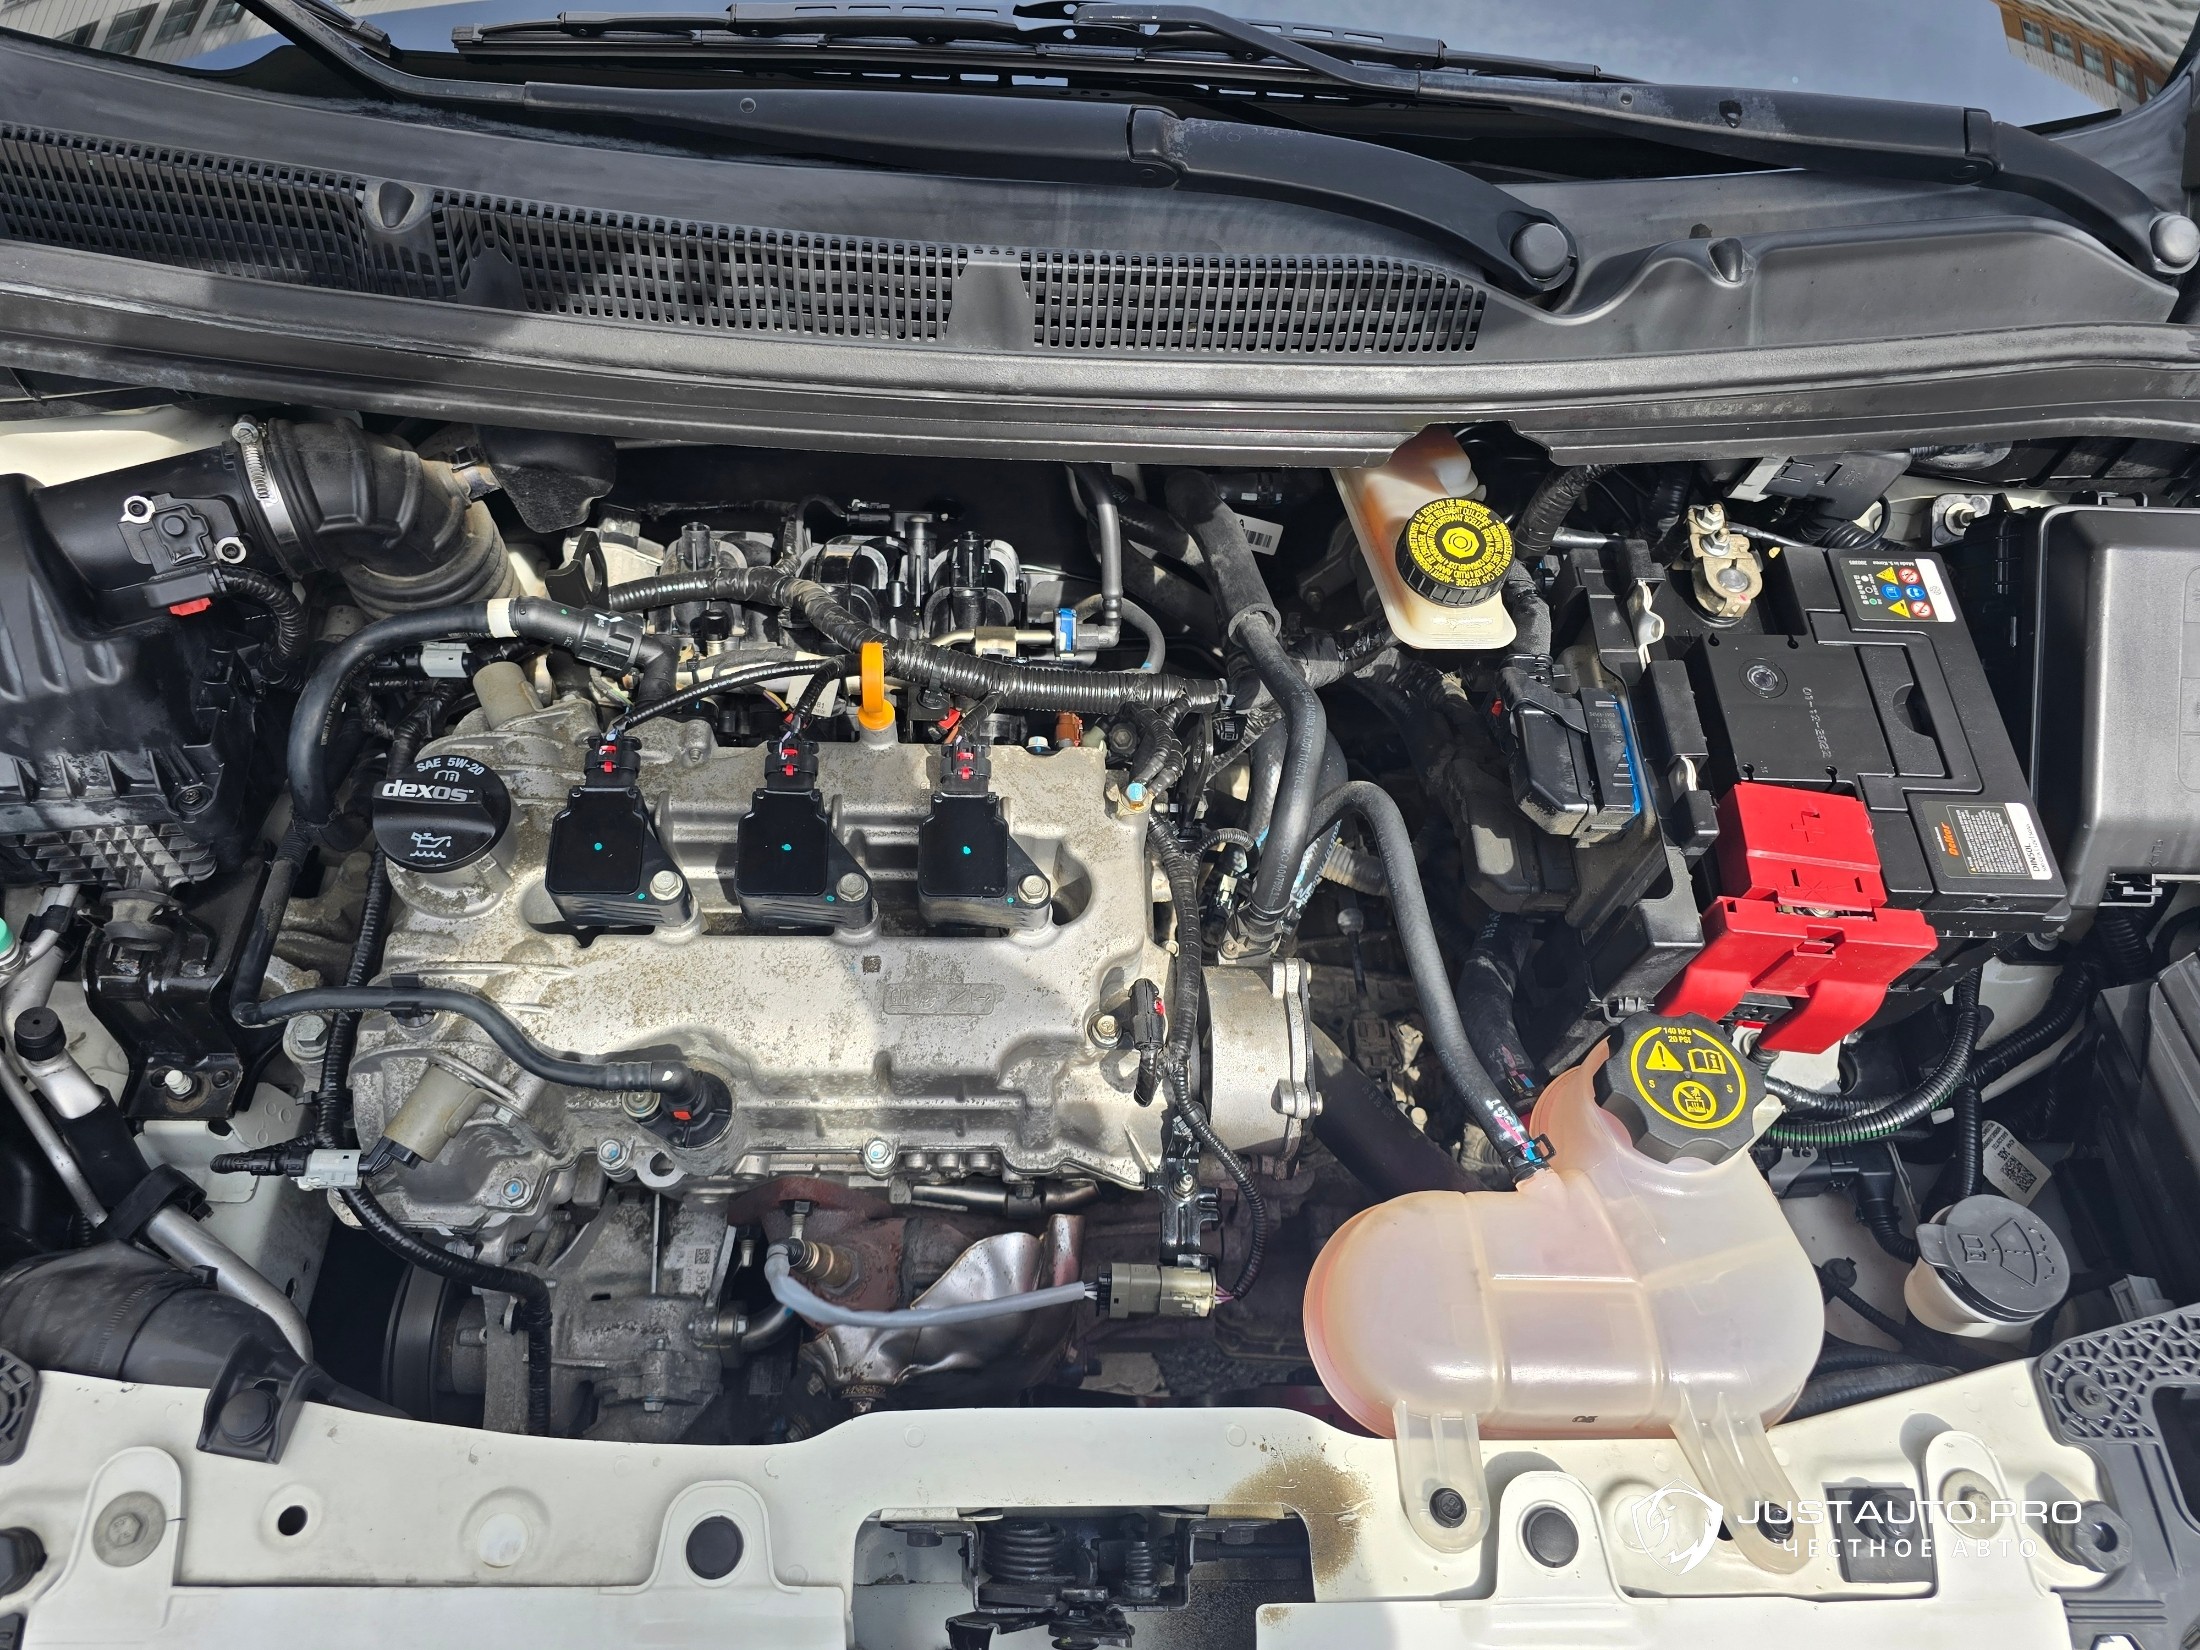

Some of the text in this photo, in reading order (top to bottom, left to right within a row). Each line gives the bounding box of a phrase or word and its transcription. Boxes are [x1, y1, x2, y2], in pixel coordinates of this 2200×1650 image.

[416, 758, 485, 776] SAE 5W-20
[382, 780, 468, 802] dexos
[1663, 1027, 1692, 1036] 140 kPa
[1679, 1036, 1692, 1044] PSI
